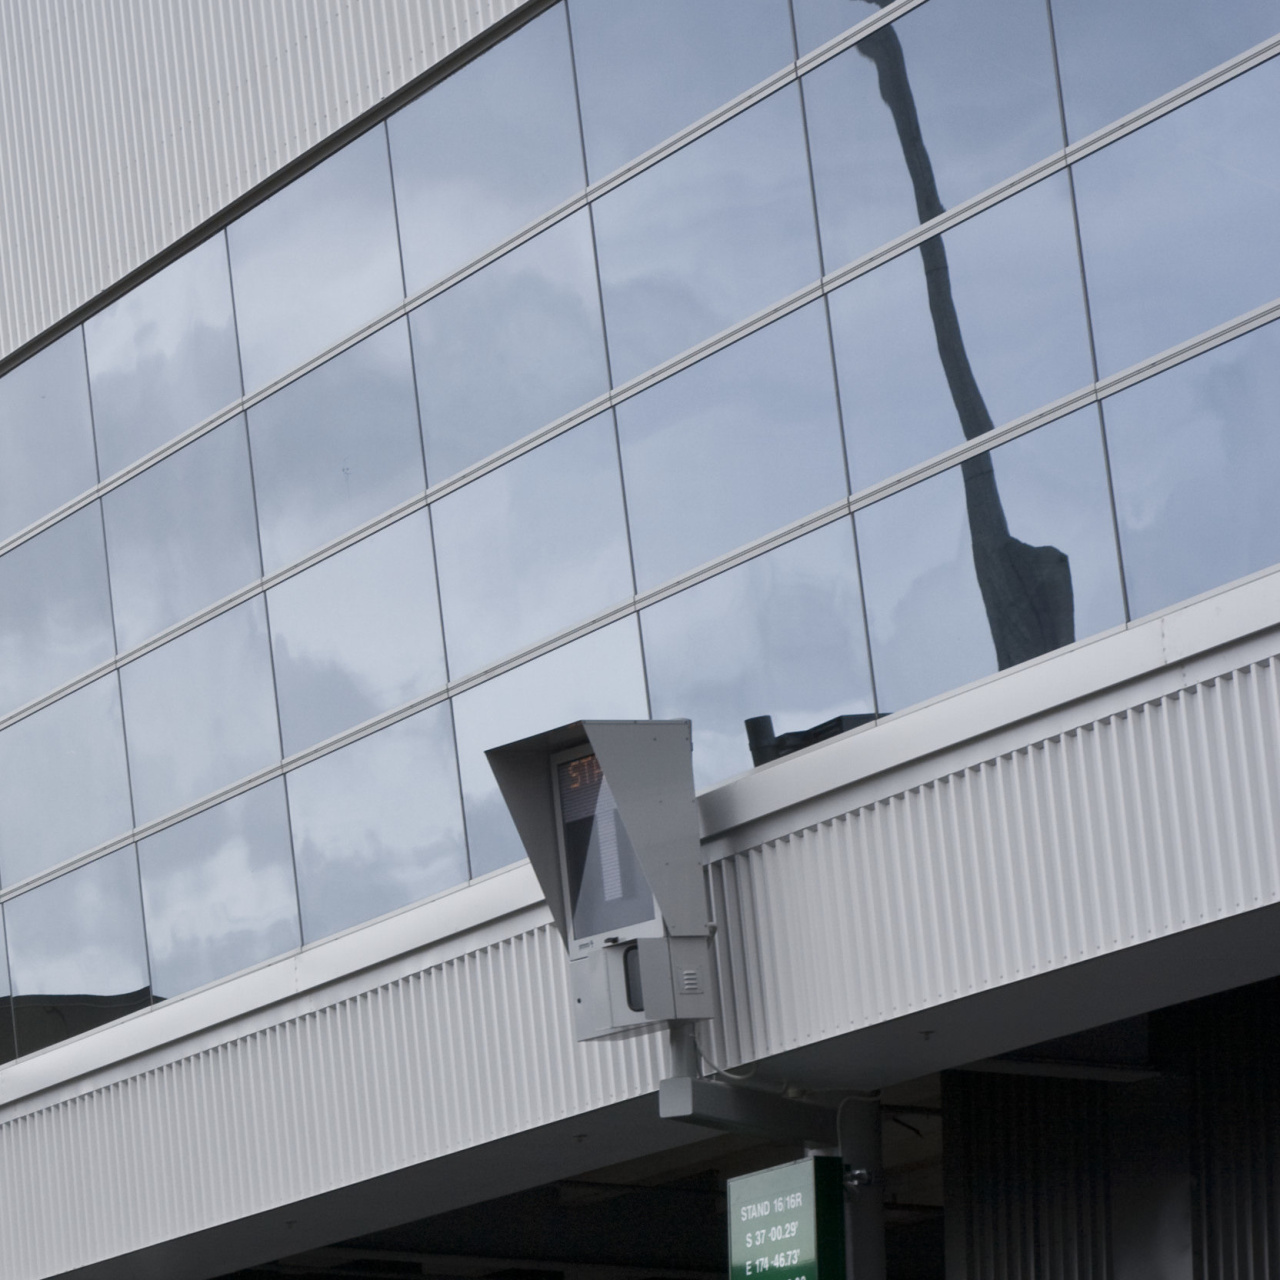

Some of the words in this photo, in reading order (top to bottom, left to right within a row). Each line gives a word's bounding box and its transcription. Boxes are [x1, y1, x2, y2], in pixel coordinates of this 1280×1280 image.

[741, 1201, 770, 1222] STAND
[746, 1233, 753, 1248] S
[755, 1230, 766, 1246] 37
[746, 1261, 752, 1276] E
[755, 1258, 769, 1274] 174
